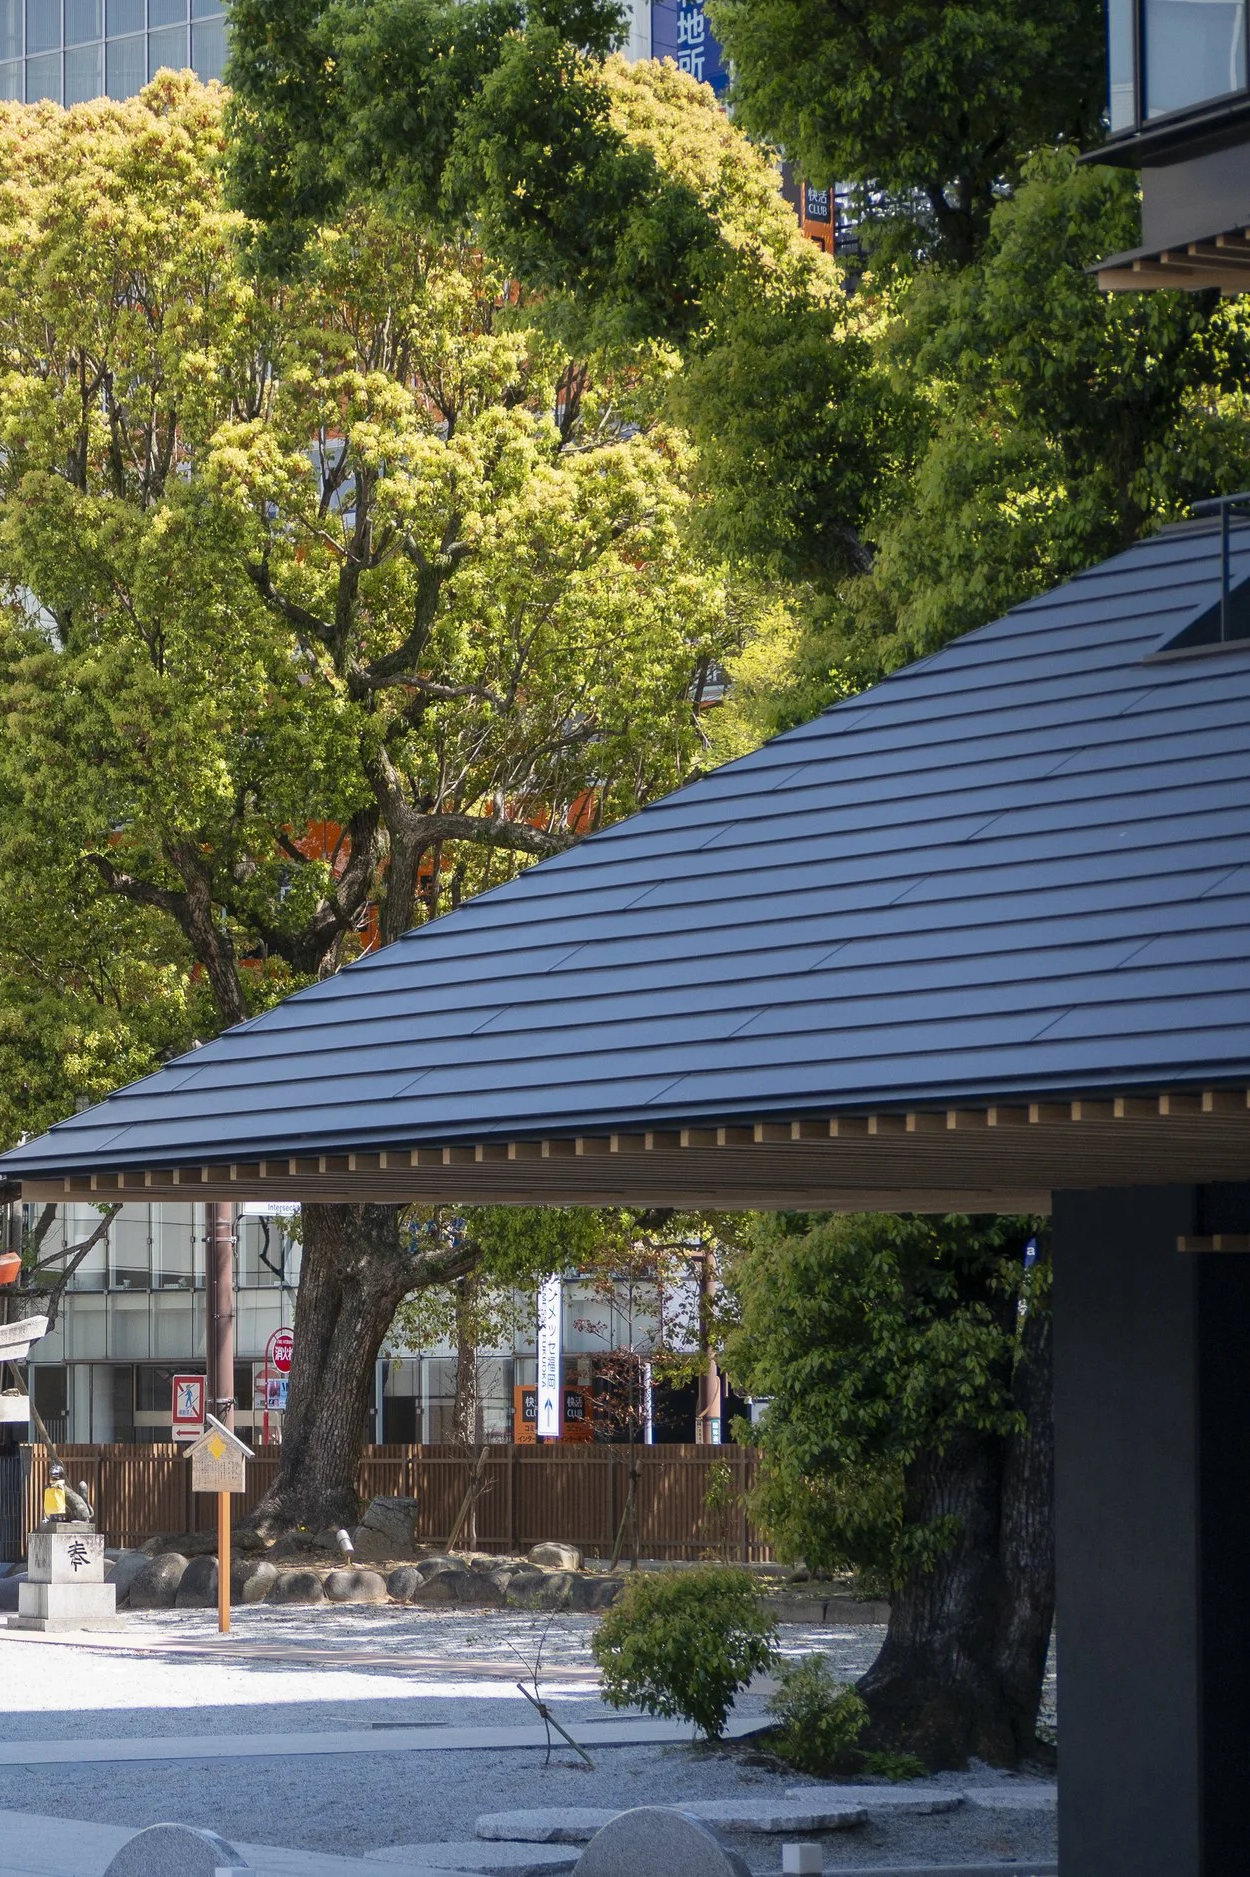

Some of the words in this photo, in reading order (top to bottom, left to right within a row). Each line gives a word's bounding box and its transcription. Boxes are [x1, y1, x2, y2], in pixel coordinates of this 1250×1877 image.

[677, 0, 704, 81] 地所
[808, 187, 827, 203] 快活
[808, 203, 827, 216] CLUB
[67, 1541, 90, 1572] 奉
